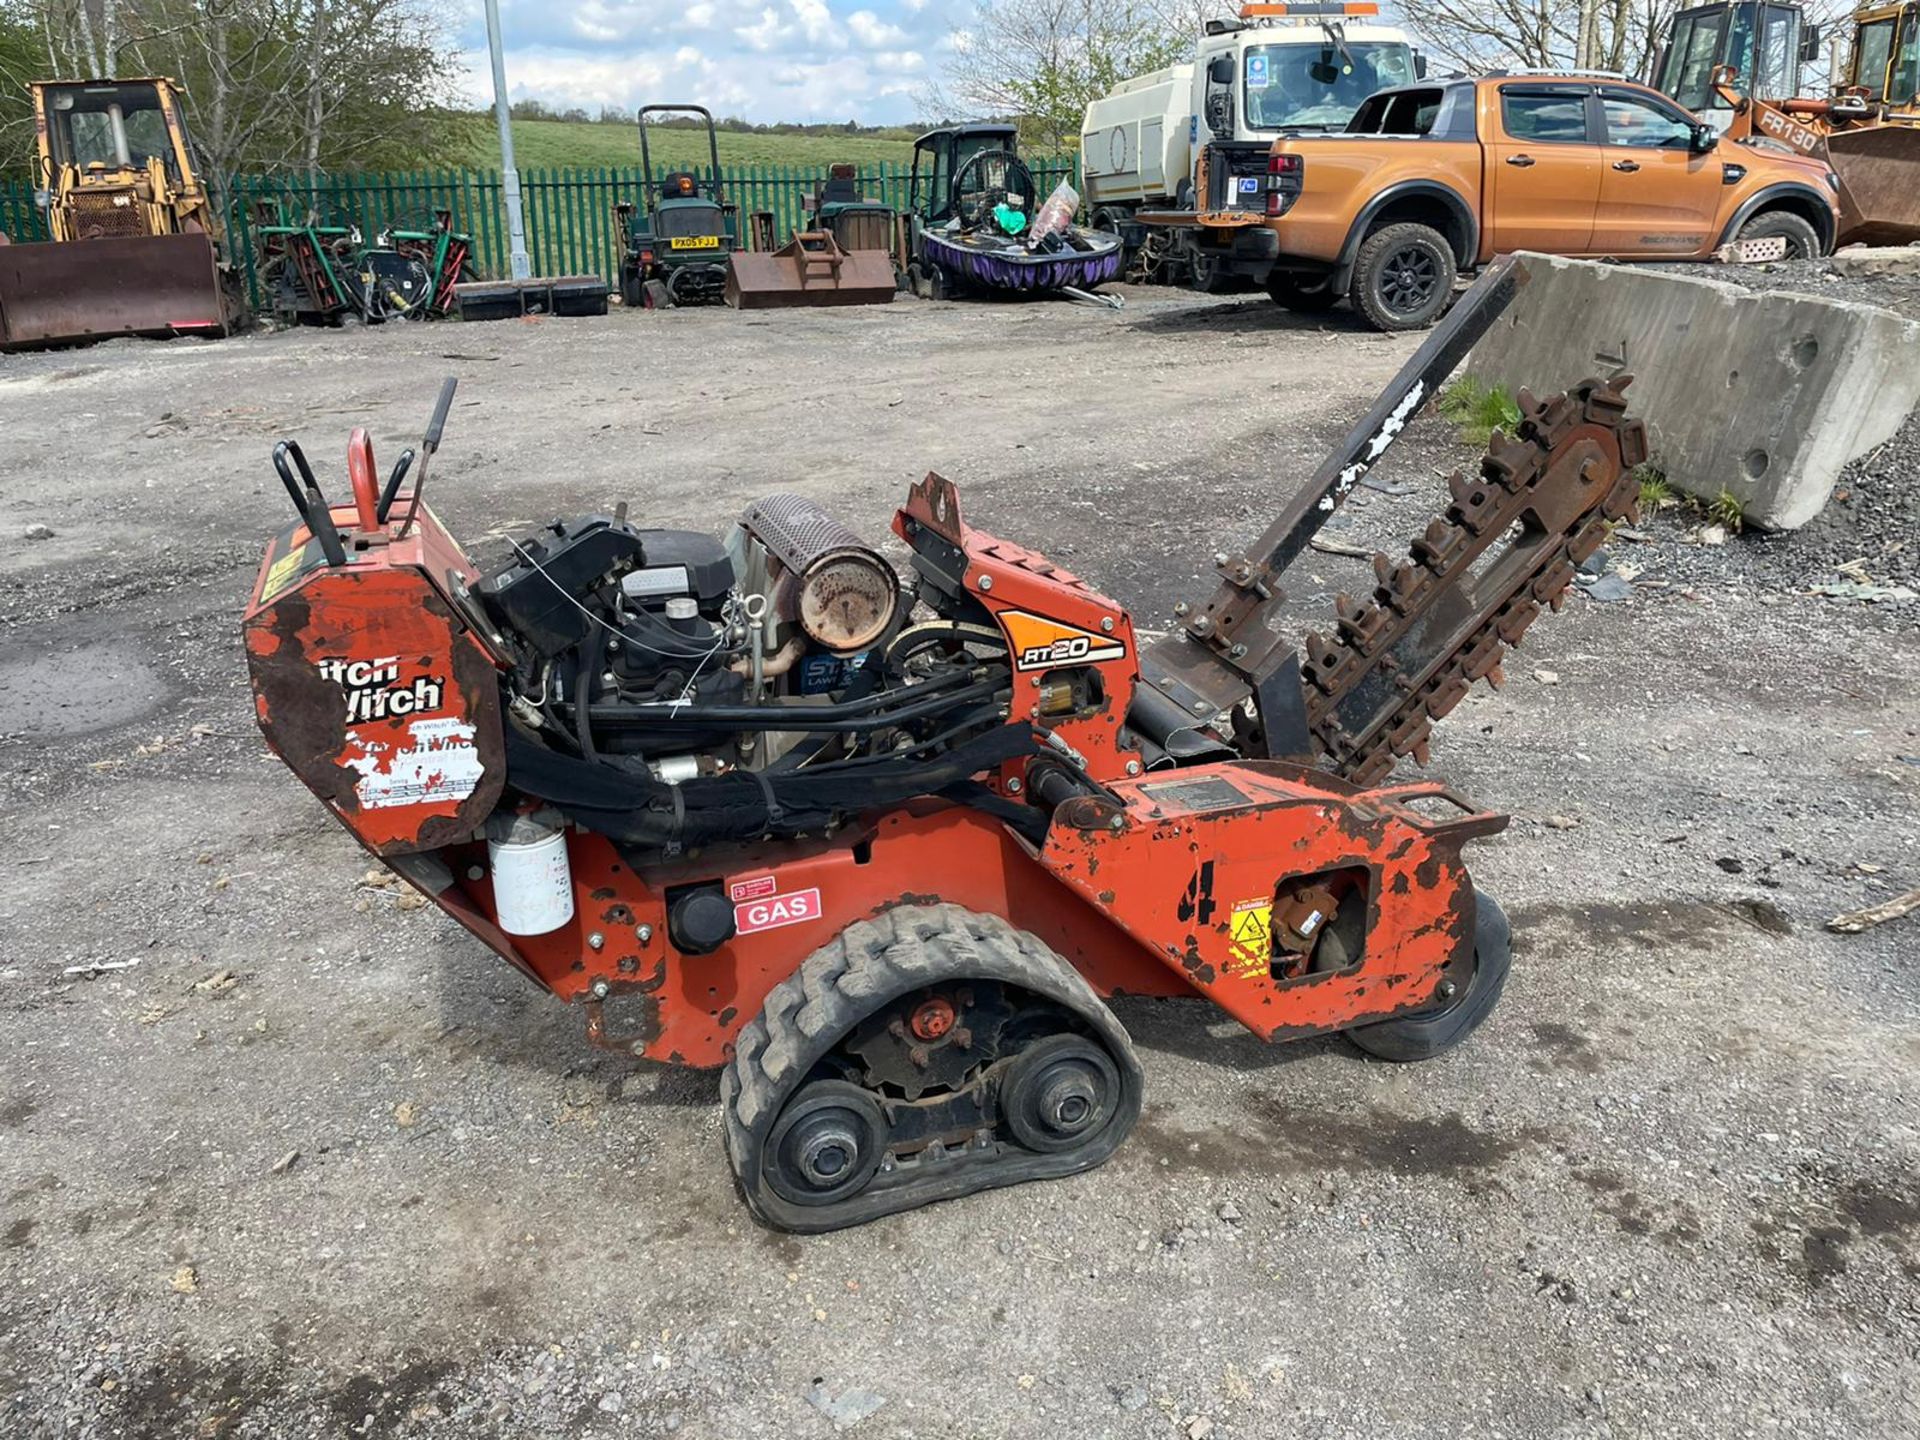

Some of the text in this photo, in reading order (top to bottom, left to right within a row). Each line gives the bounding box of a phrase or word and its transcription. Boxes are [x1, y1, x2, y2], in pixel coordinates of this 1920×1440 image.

[1761, 110, 1817, 151] FR130
[1024, 637, 1090, 663] RT20
[319, 656, 398, 686] itch
[748, 898, 807, 925] GAS
